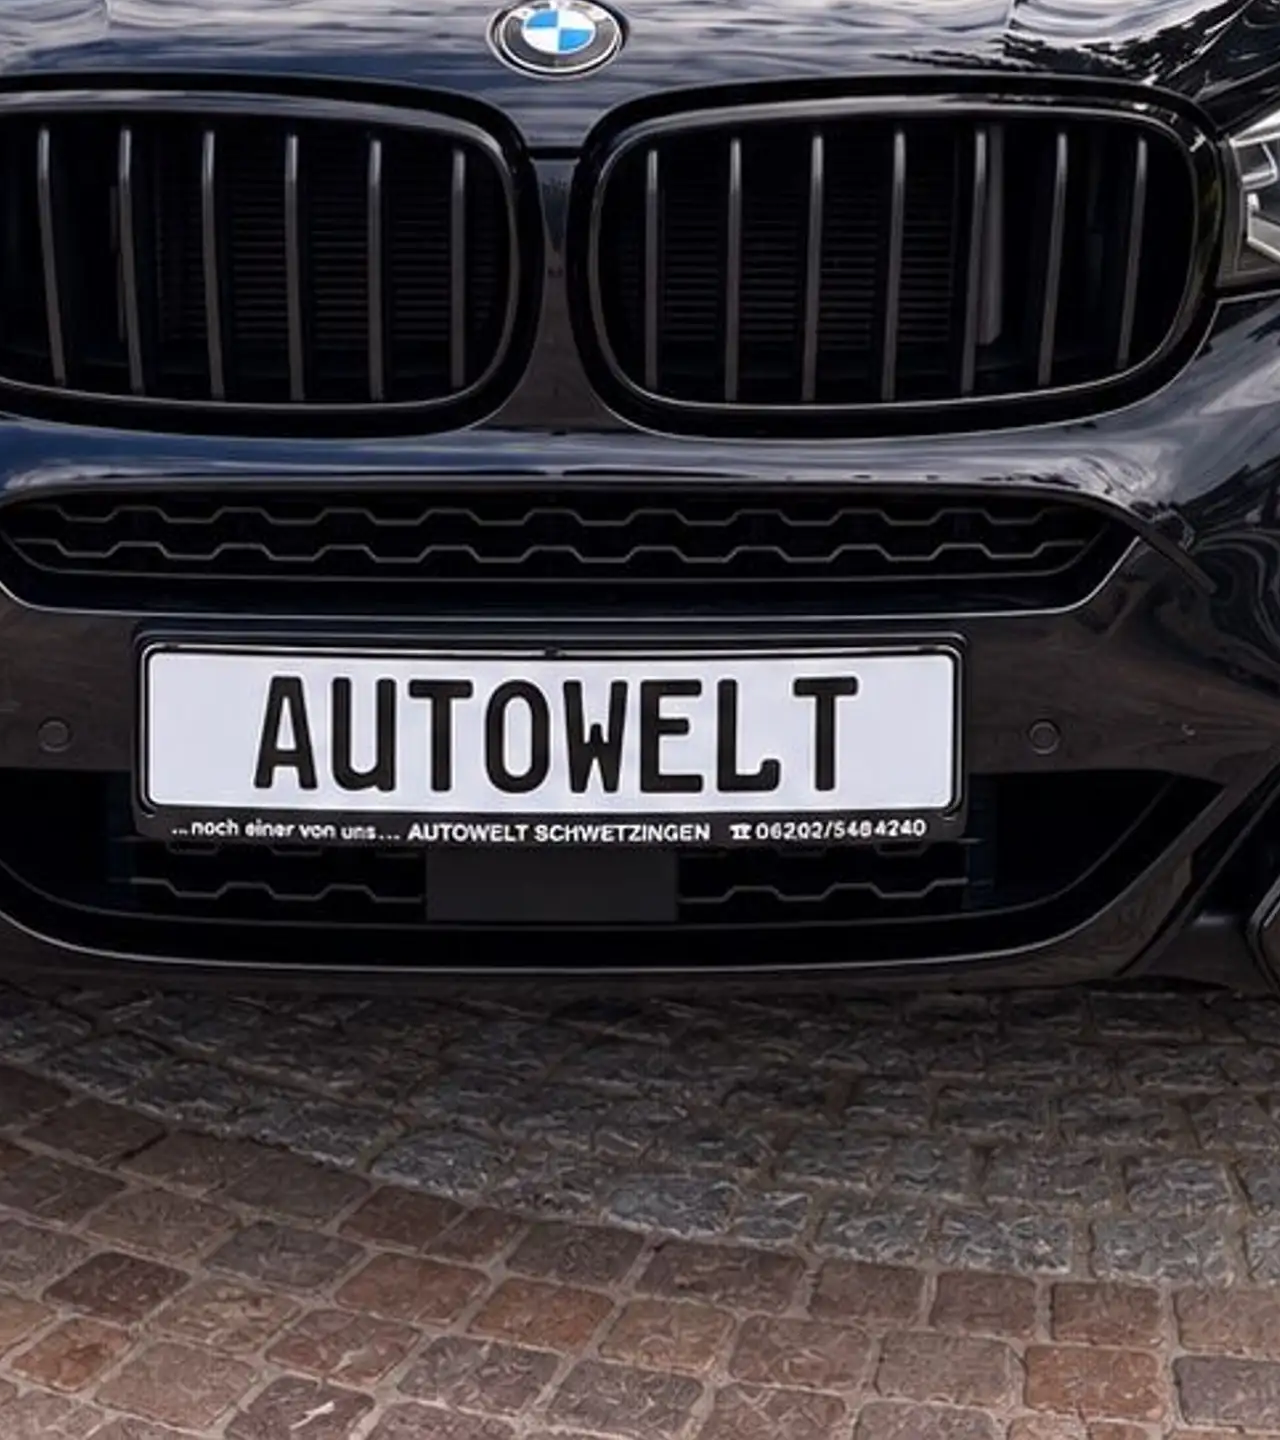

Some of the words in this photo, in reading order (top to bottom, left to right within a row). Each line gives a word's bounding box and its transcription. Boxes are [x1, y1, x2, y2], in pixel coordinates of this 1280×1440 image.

[254, 676, 858, 793] AUTOWELT
[245, 819, 295, 837] einer
[299, 824, 336, 839] von
[407, 823, 528, 843] AUTOWELT
[533, 823, 711, 843] SCHWETZINGEN
